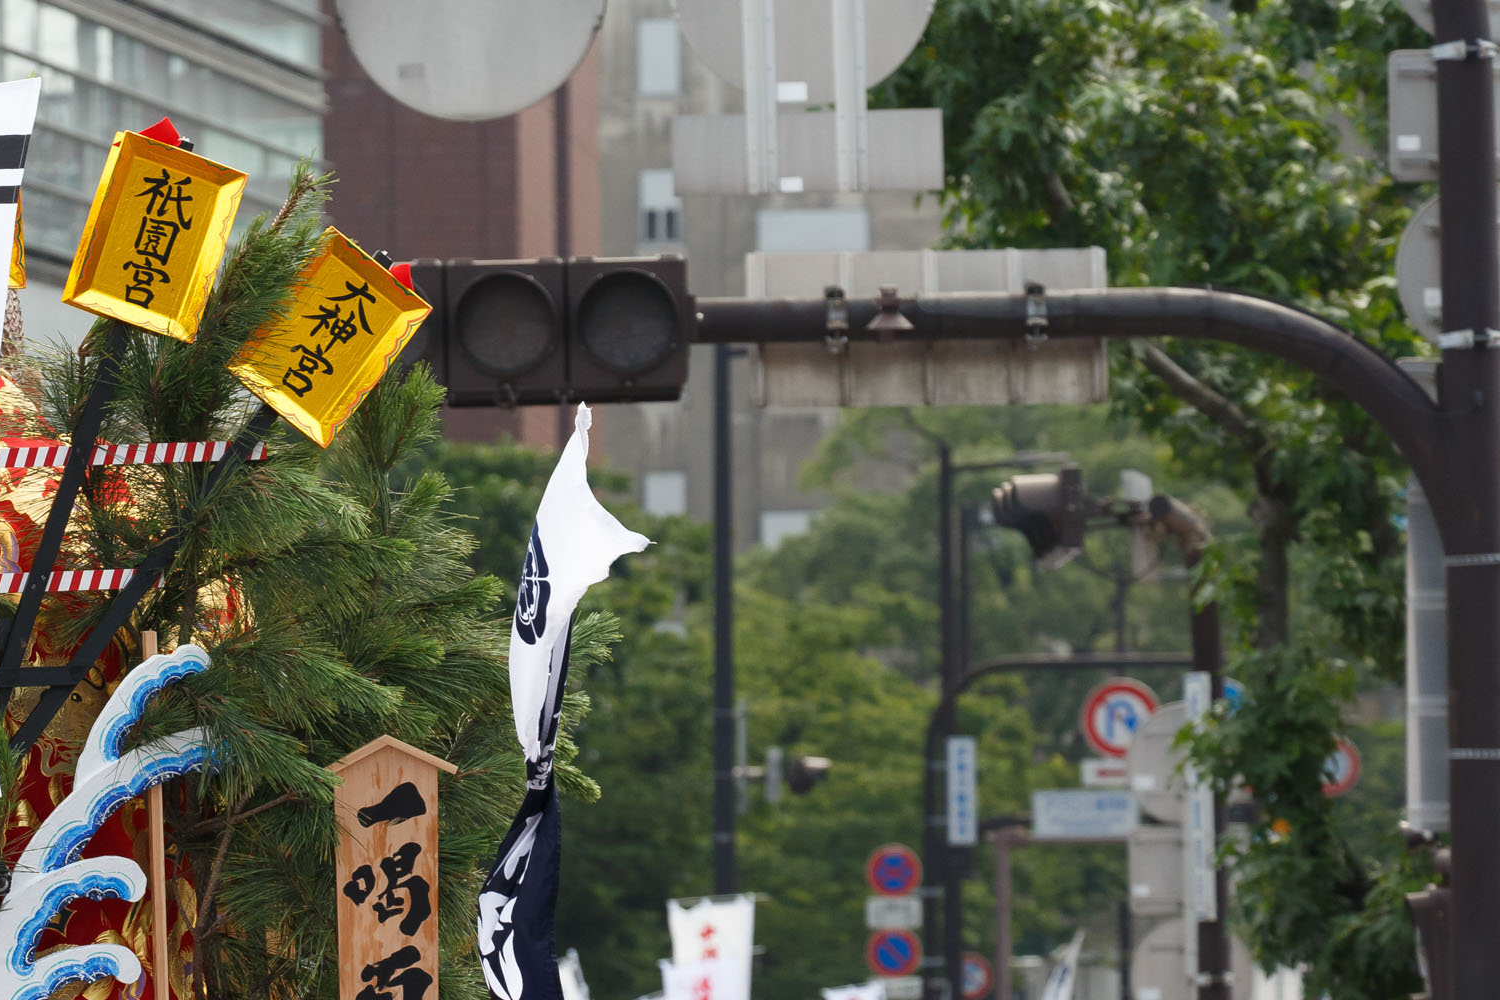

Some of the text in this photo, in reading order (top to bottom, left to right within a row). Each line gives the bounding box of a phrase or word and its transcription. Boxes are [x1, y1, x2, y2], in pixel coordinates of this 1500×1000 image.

[122, 168, 194, 310] 祇園宮
[282, 280, 377, 398] 大神宮
